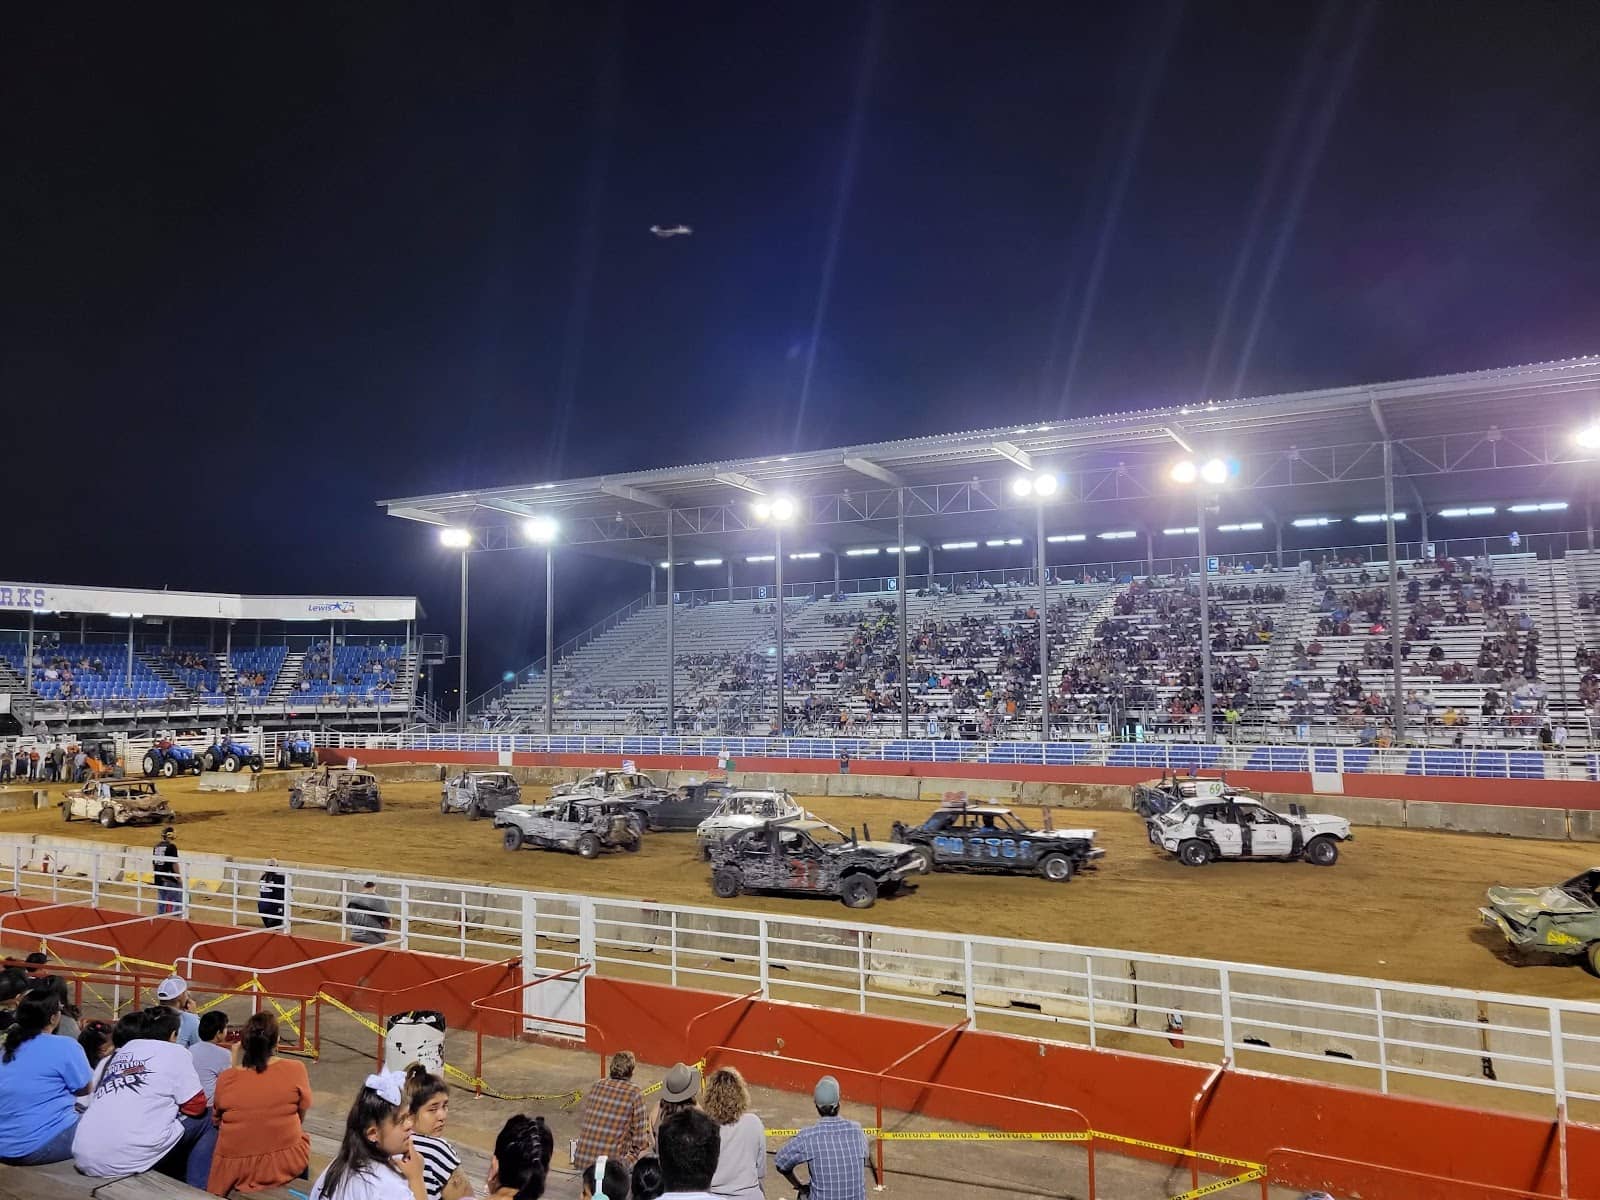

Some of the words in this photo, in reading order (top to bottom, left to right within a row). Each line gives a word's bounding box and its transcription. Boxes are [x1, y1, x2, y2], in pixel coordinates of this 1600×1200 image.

[1209, 783, 1222, 795] 69
[94, 1073, 148, 1099] DERBY
[1196, 1177, 1241, 1195] CAUTION
